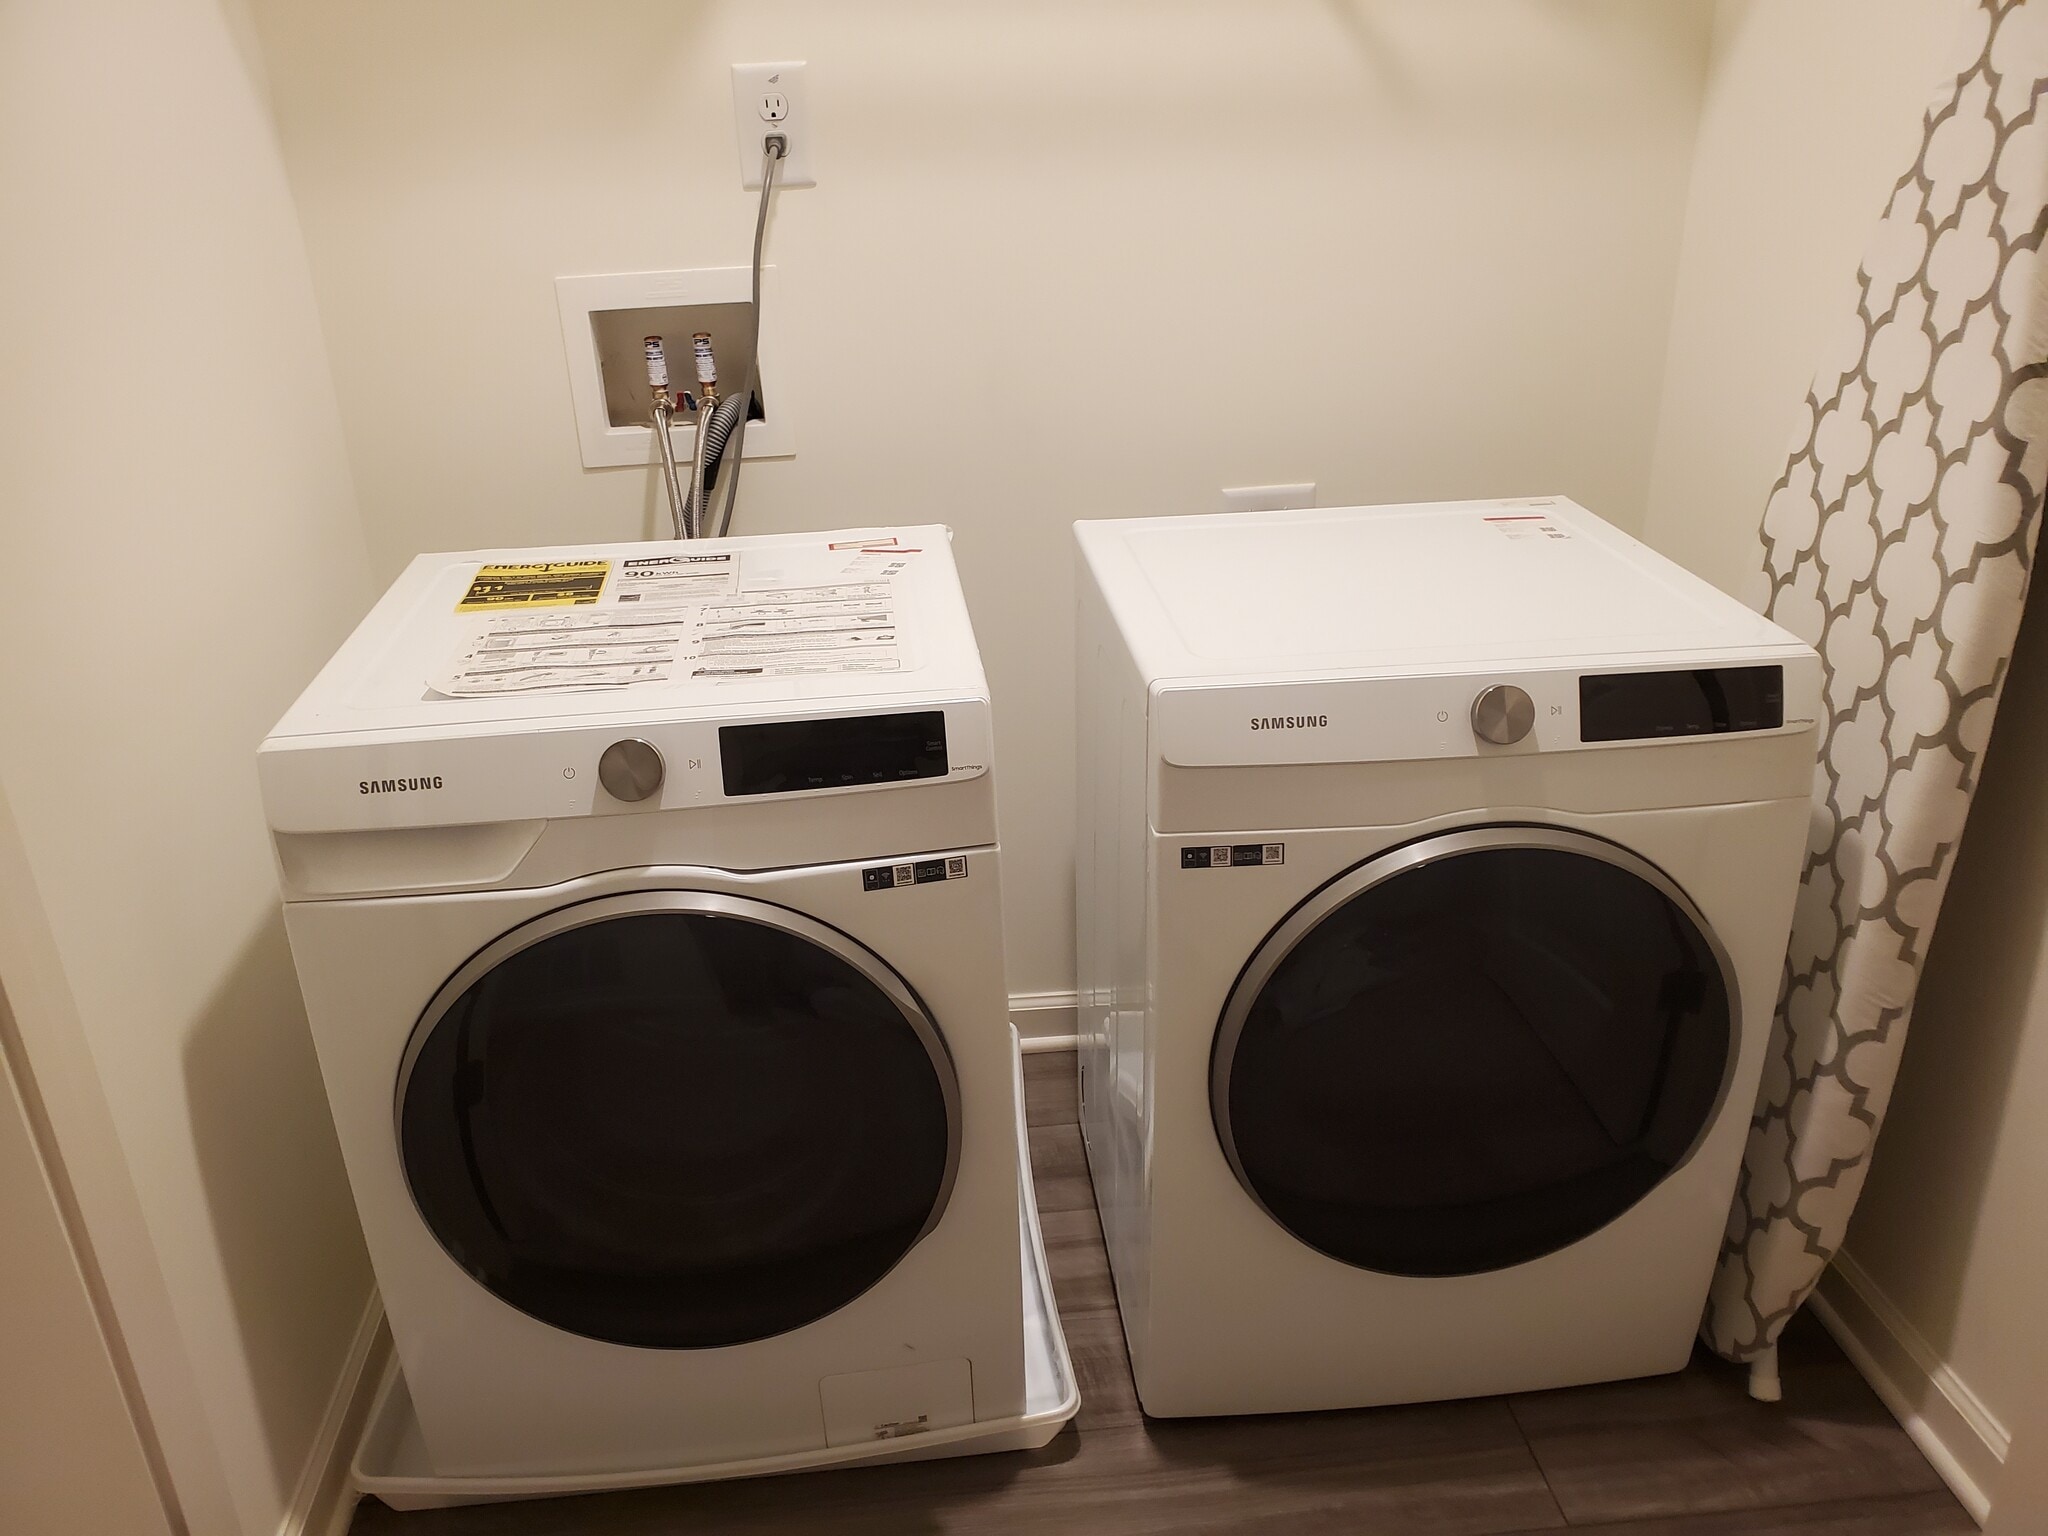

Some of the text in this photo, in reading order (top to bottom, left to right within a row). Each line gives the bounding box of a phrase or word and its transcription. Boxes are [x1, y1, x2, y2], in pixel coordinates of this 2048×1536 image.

[482, 560, 608, 572] ENERGYGUIDE
[624, 570, 655, 578] 90
[1250, 715, 1328, 731] SAMSUNG
[951, 764, 983, 772] SmartThings
[359, 776, 443, 794] SAMSUNG
